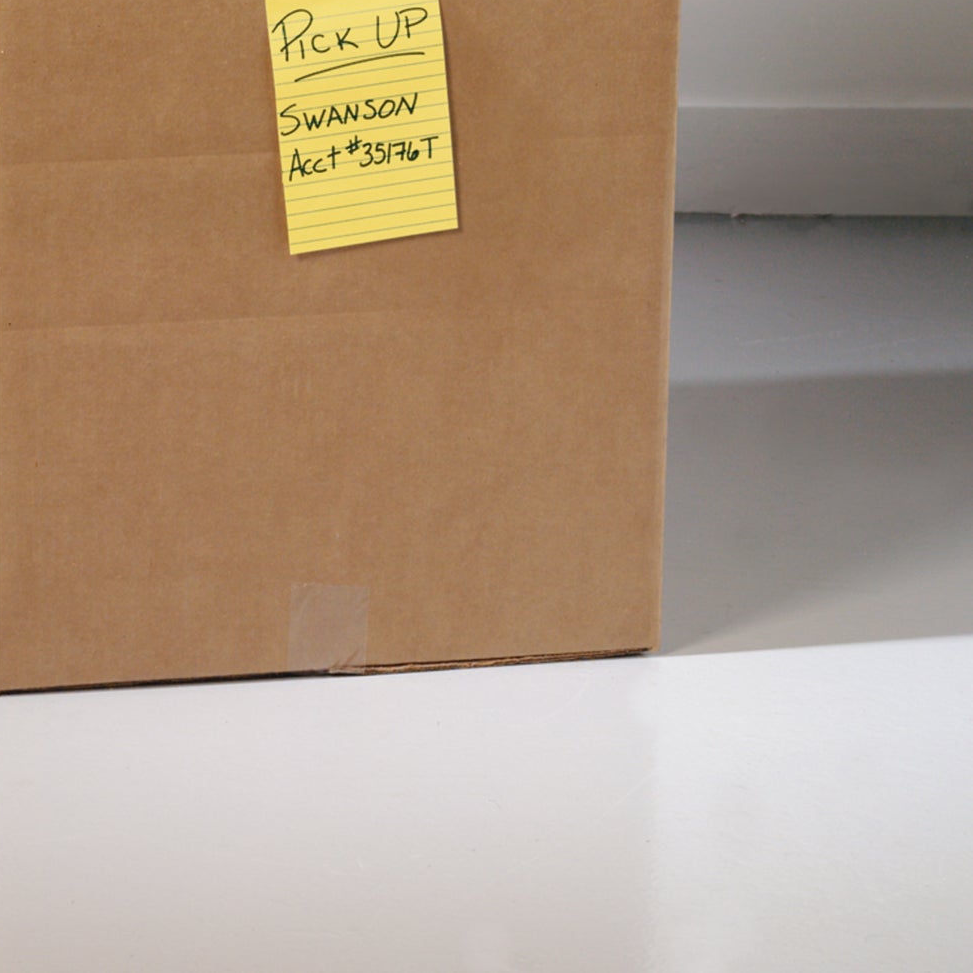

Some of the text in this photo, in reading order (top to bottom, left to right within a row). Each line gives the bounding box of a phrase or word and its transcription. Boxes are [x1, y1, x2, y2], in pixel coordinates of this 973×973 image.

[271, 6, 429, 62] PICK UP
[279, 92, 419, 137] SWANSON
